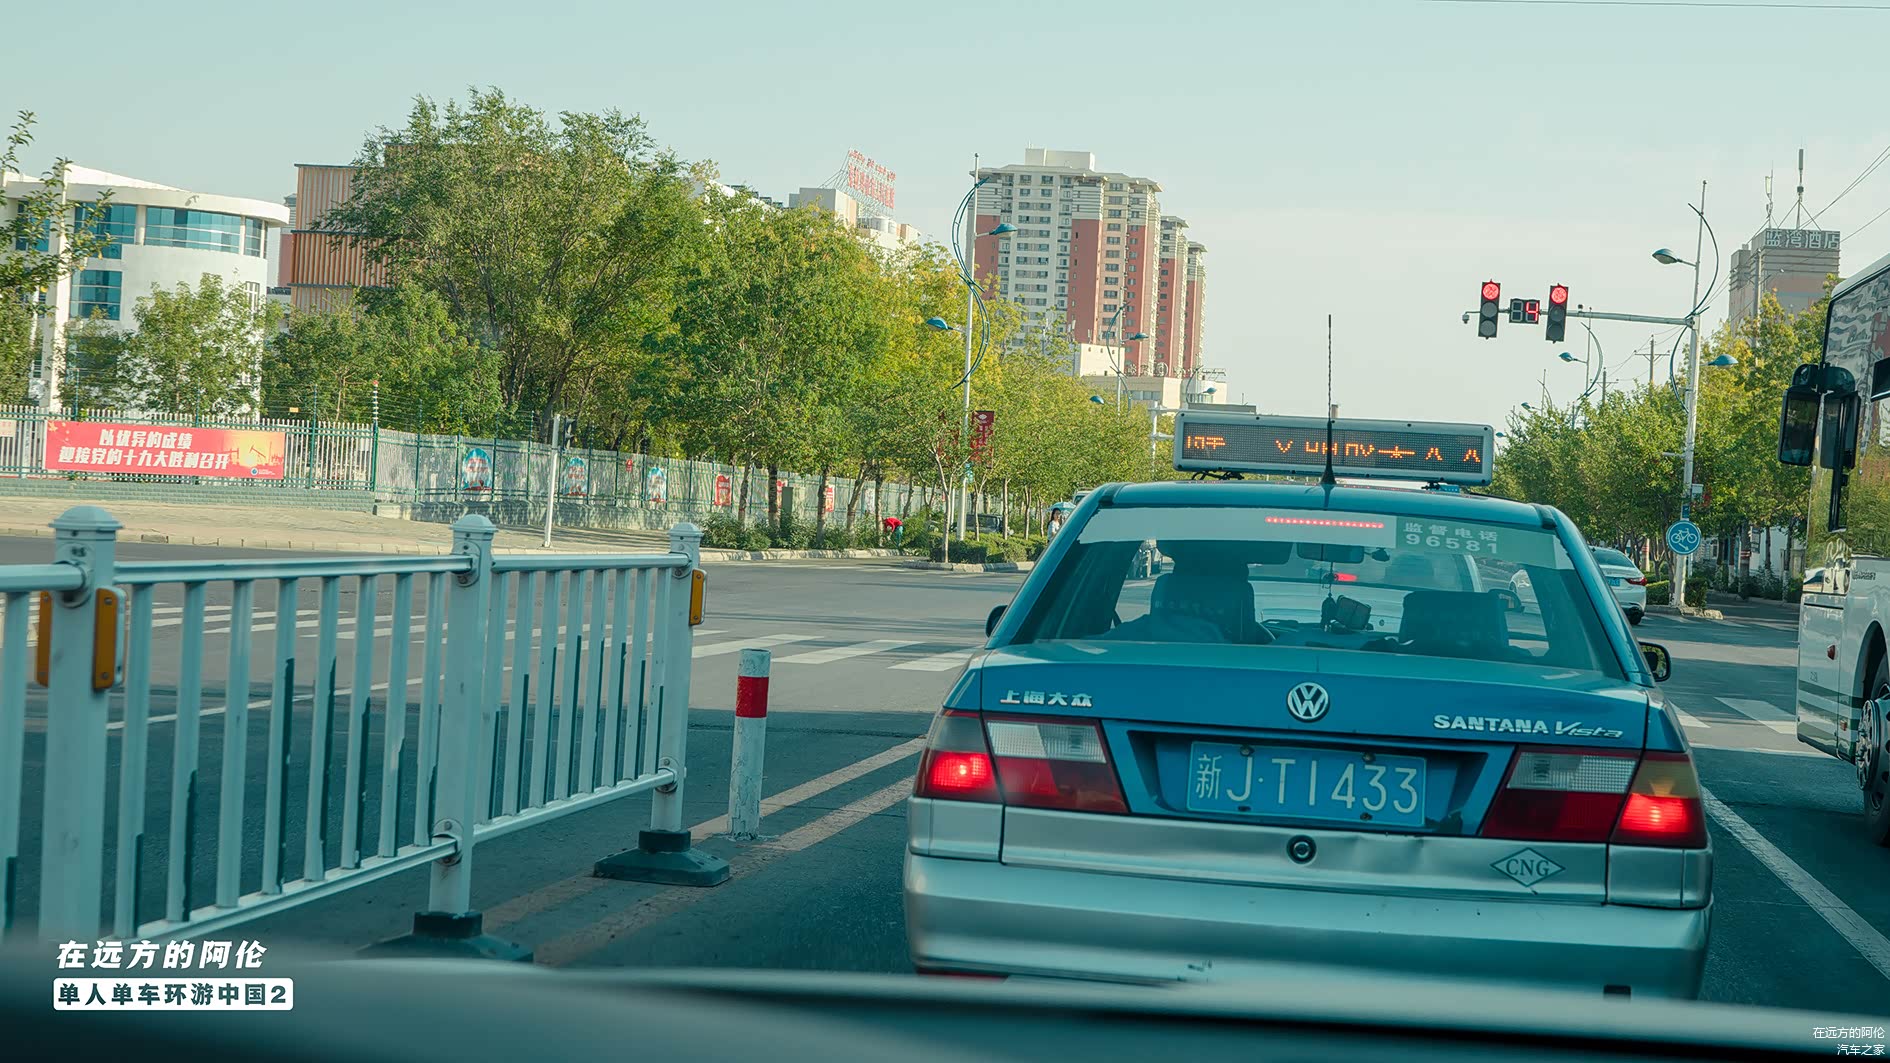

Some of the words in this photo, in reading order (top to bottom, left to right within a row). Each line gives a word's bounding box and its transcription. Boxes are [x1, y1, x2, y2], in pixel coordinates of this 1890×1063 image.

[1766, 229, 1840, 248] 蓝湾酒店
[1526, 301, 1538, 320] 4
[99, 429, 193, 450] 以优异的成绩
[58, 446, 231, 470] 迎接党的十九大胜利召开
[1403, 522, 1497, 541] 监督电话
[1406, 533, 1497, 554] 96581
[1000, 689, 1092, 707] 上海大众
[1433, 714, 1549, 734] SANTANA
[1554, 720, 1624, 738] Vista
[1506, 858, 1549, 876] CNG
